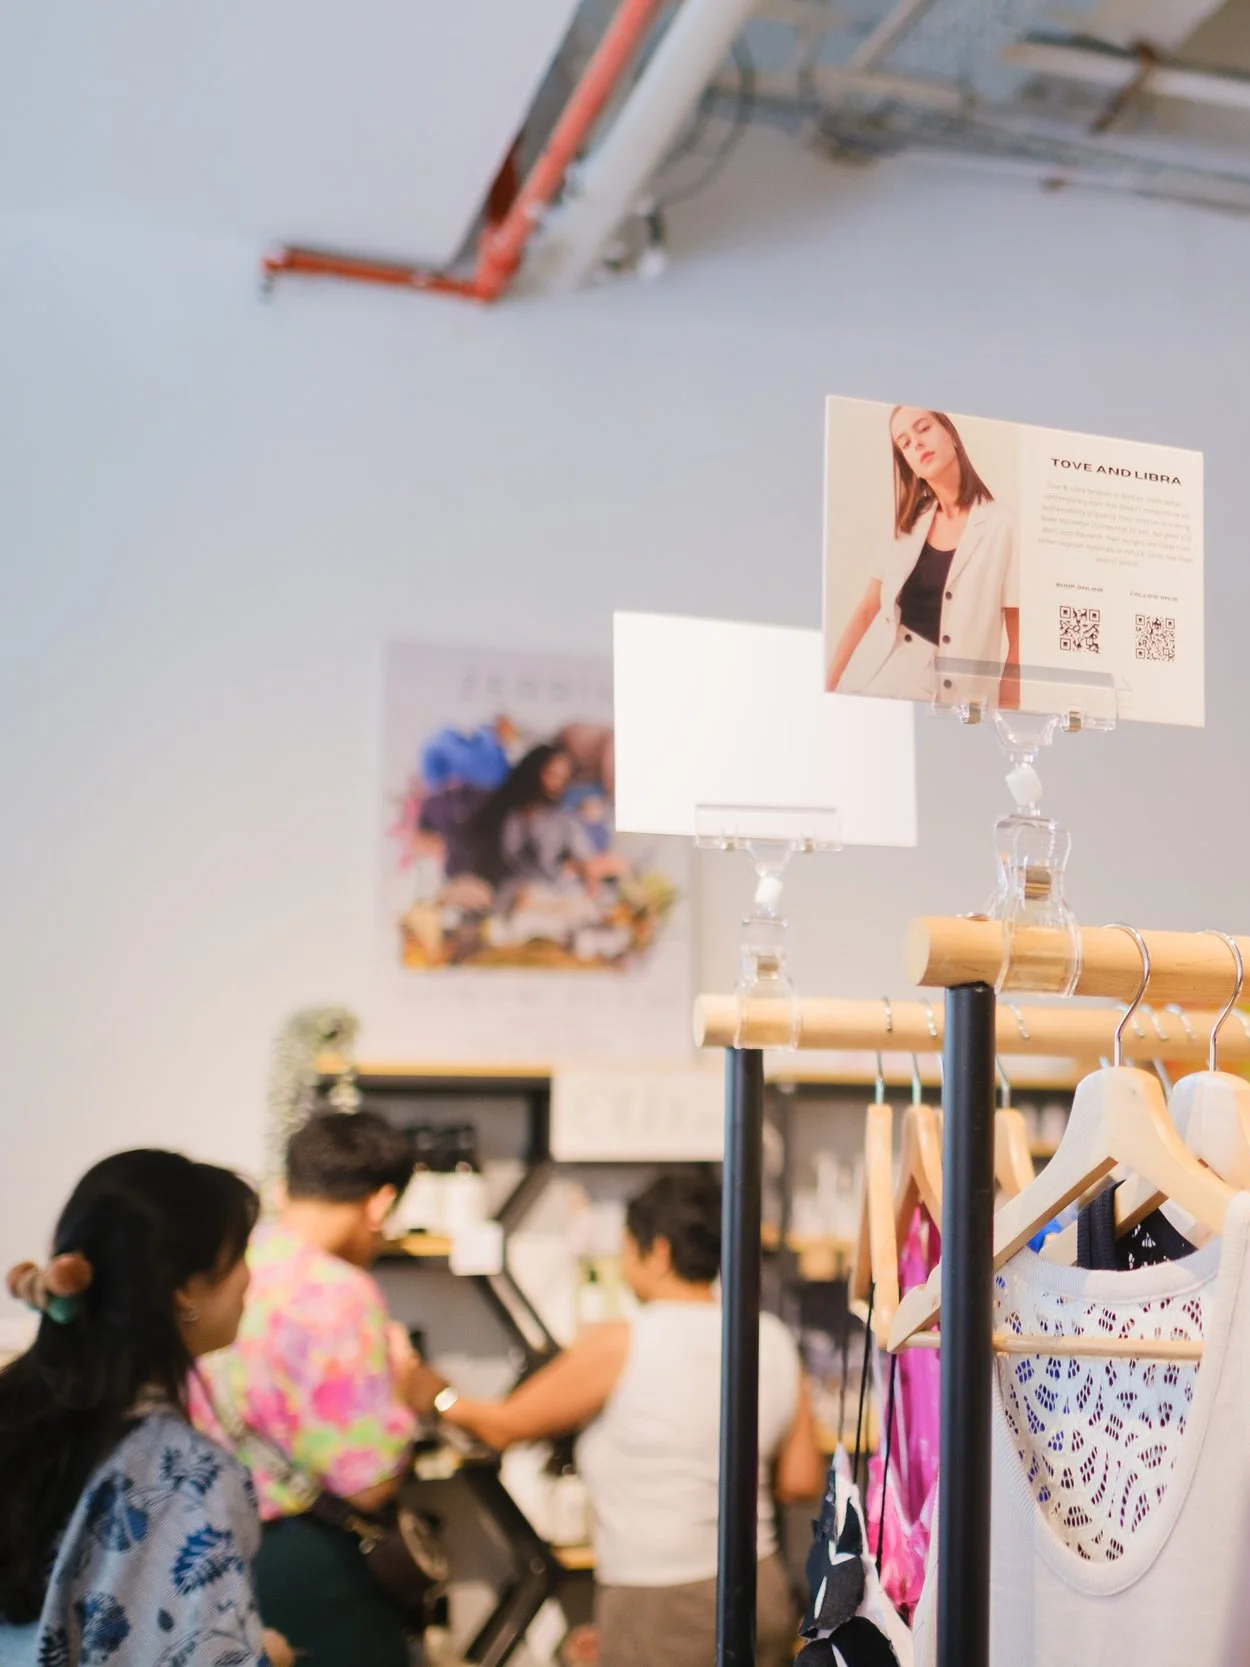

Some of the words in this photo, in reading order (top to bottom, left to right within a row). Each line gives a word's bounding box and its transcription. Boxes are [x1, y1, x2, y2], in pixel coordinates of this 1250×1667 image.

[1051, 458, 1093, 473] TOVE
[1096, 465, 1132, 477] AND
[1135, 470, 1182, 486] LIBRA
